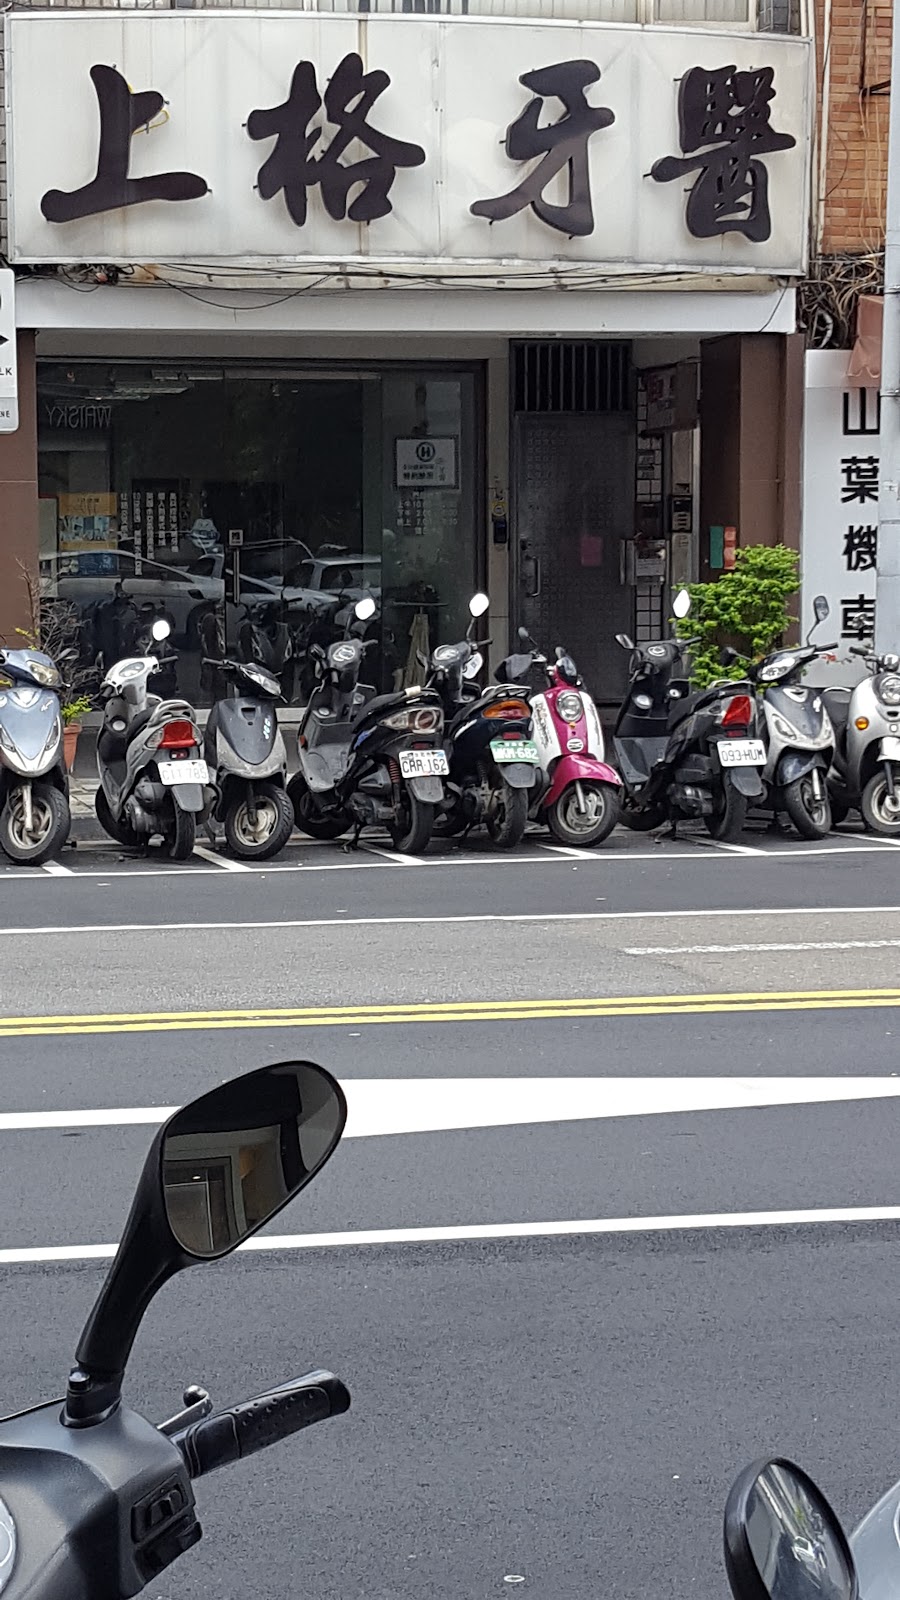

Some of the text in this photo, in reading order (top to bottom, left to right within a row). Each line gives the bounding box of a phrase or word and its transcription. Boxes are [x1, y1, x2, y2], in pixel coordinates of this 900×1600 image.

[41, 52, 796, 242] 上格牙醫
[841, 387, 881, 640] 山葉機車
[720, 748, 765, 762] 093-HUM
